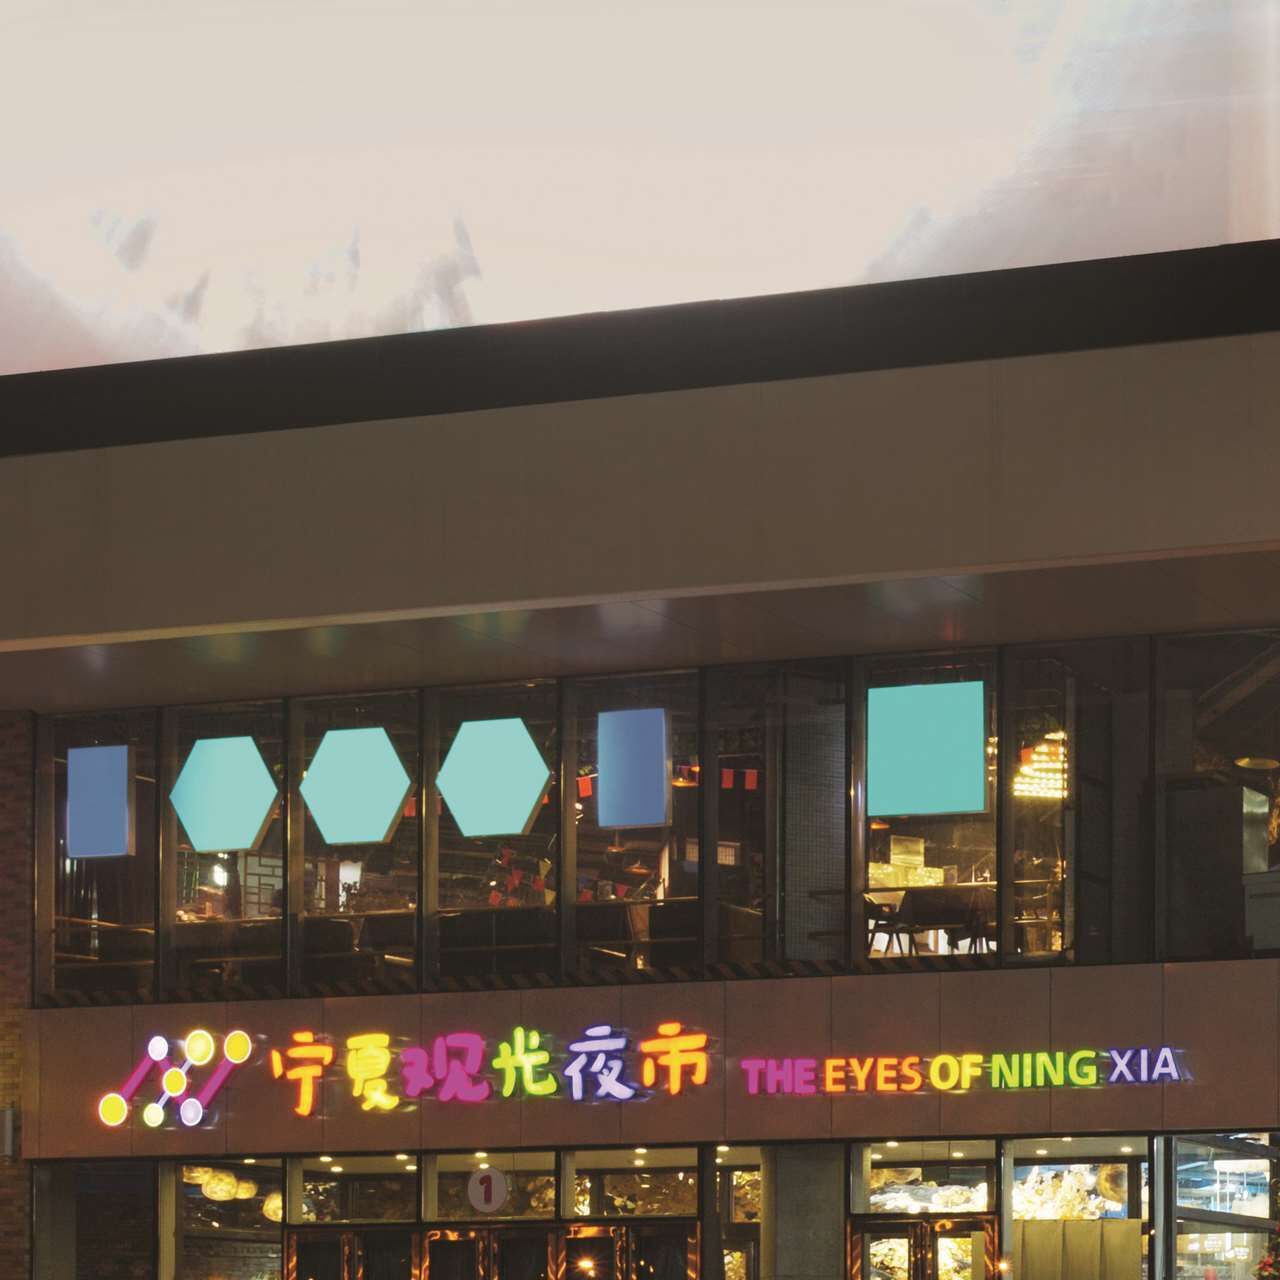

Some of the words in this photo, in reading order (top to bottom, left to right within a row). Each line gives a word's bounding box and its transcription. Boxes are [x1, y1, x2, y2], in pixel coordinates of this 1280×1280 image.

[271, 1022, 708, 1116] 宁夏观光夜市
[740, 1058, 817, 1094] THE
[823, 1056, 922, 1093] EYES
[929, 1054, 984, 1091] OF
[991, 1051, 1098, 1088] NING
[1109, 1047, 1181, 1083] XIA
[479, 1174, 492, 1205] 1
